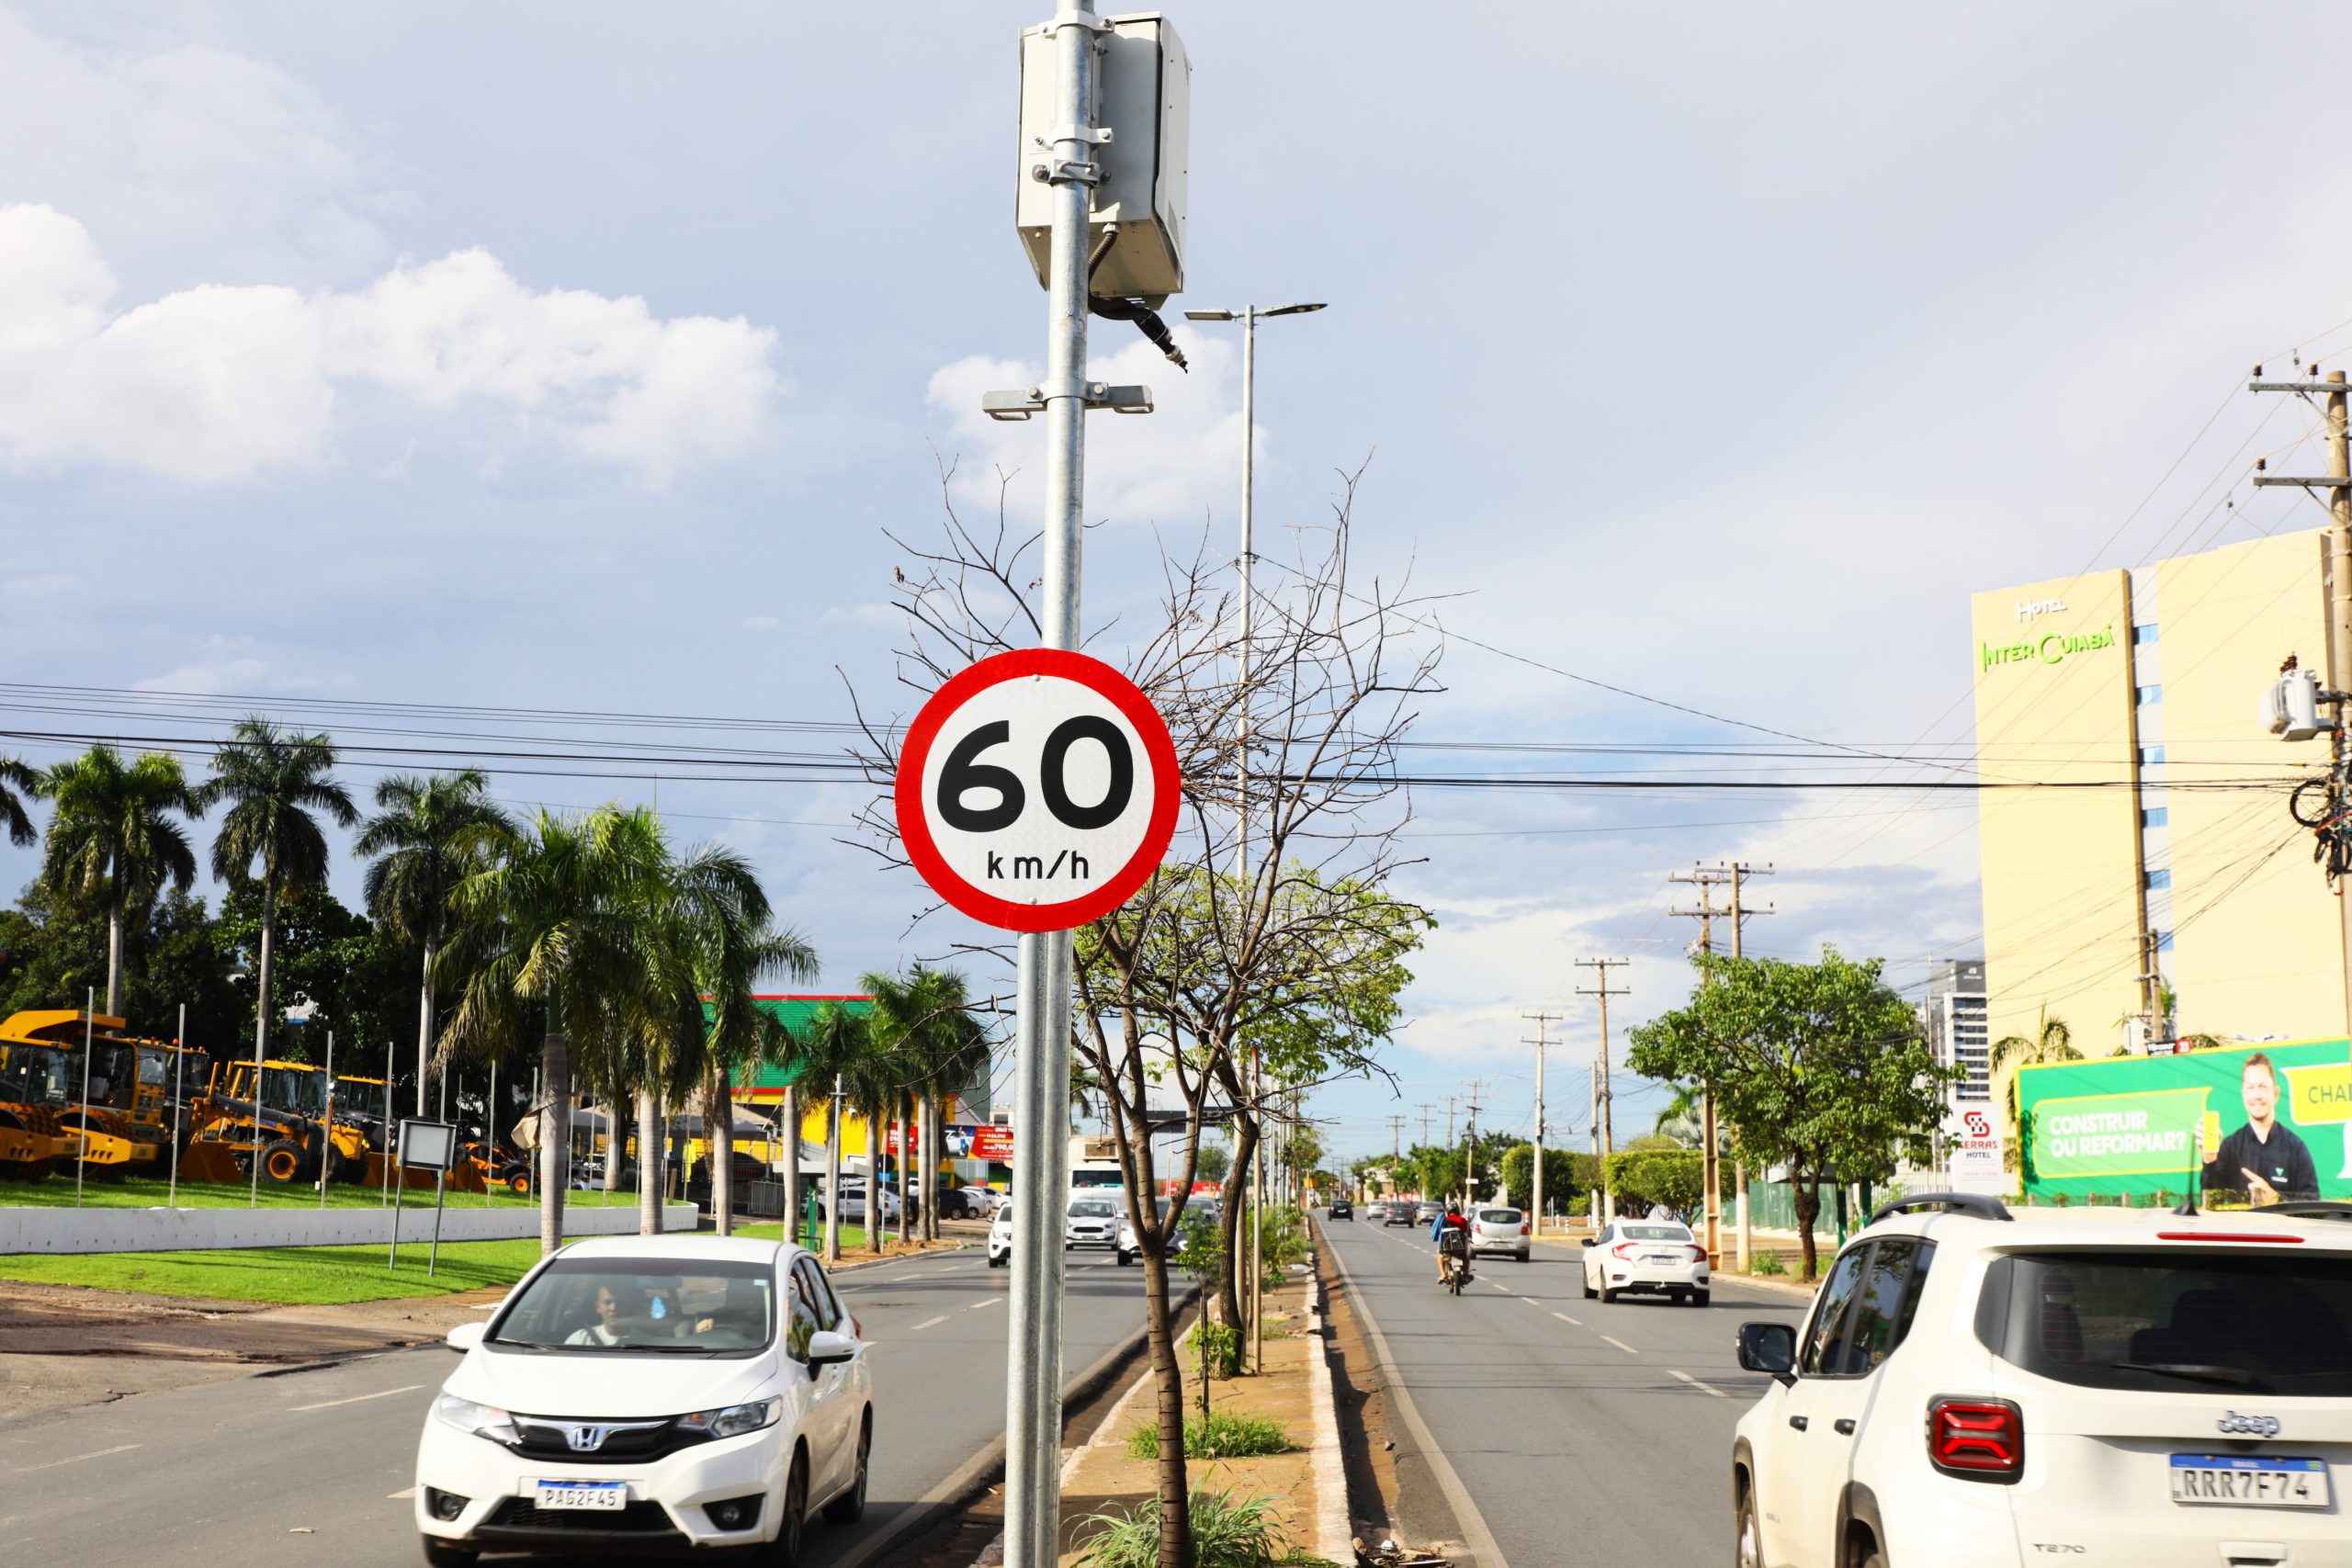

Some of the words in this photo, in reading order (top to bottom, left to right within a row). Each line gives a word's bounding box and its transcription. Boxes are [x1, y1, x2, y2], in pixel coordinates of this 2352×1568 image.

[1982, 640, 2034, 672] INTER
[937, 715, 1134, 832] 60
[987, 850, 1089, 880] km/h
[2308, 1083, 2352, 1104] CHA
[2049, 1110, 2148, 1135] CONSTRUIR
[2050, 1137, 2077, 1157] OU
[2079, 1131, 2187, 1156] REFORMAR?
[2216, 1410, 2281, 1438] Jeep
[2184, 1470, 2309, 1500] RRR7F74
[2031, 1543, 2086, 1553] T270
